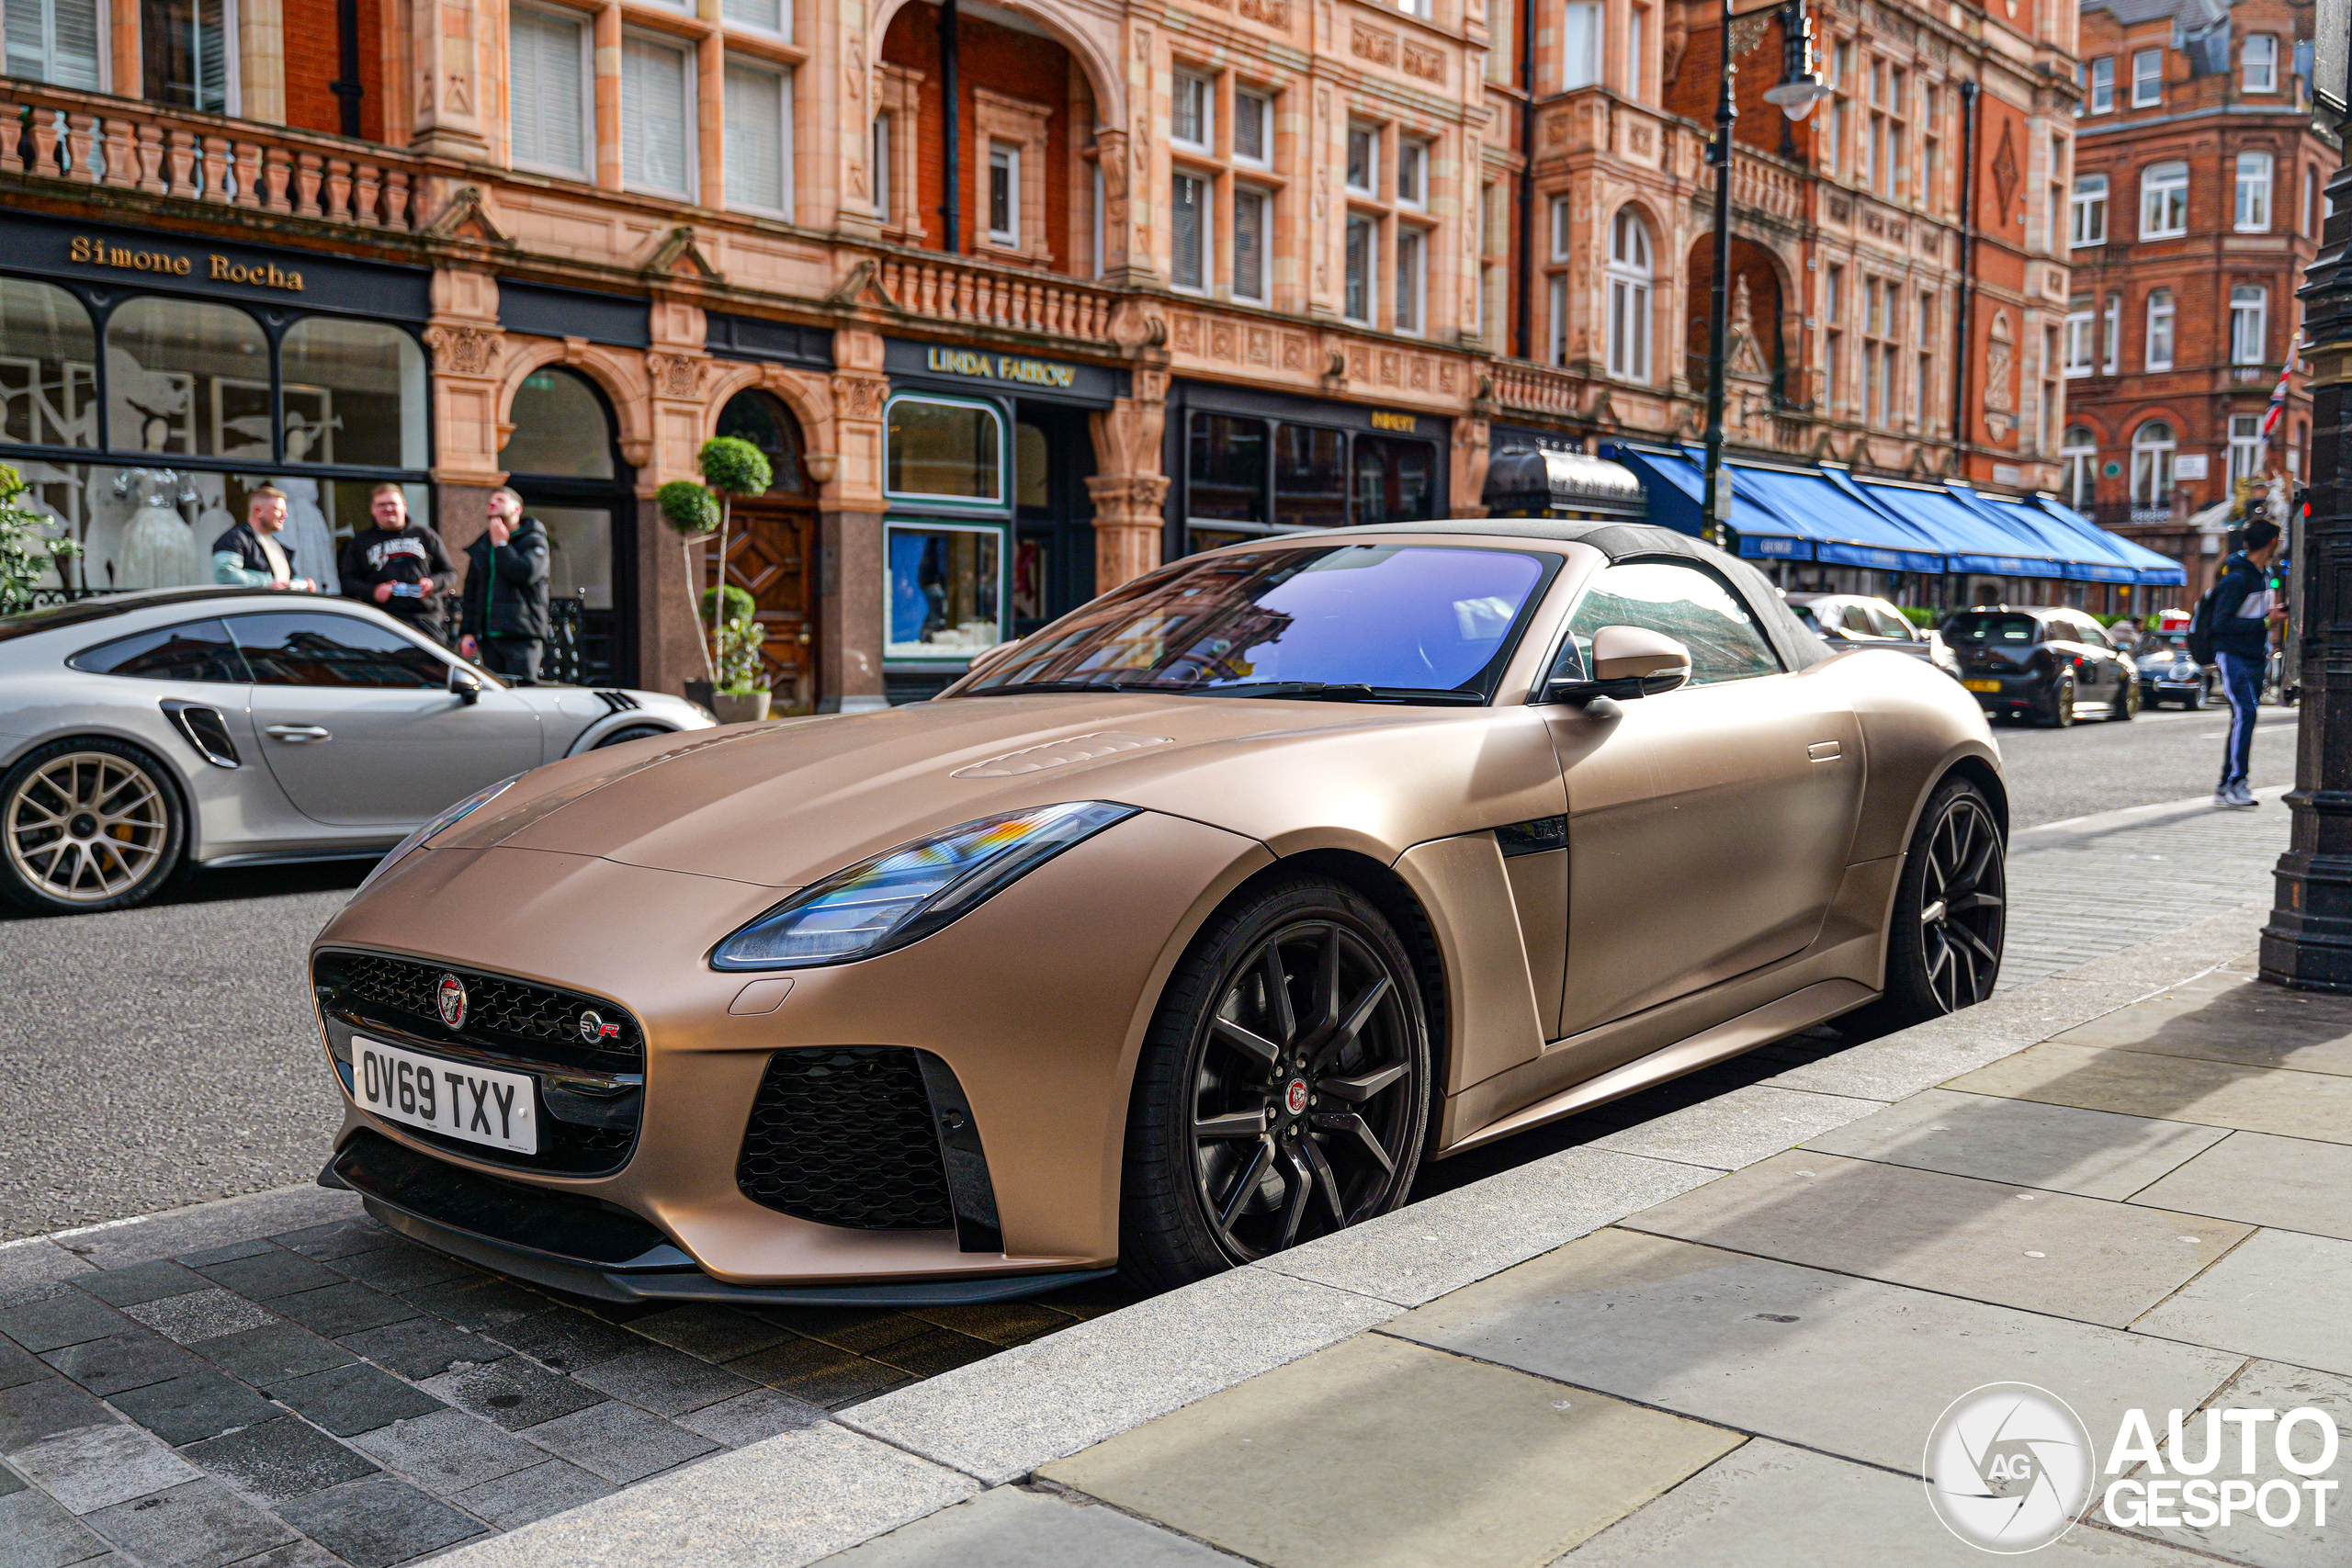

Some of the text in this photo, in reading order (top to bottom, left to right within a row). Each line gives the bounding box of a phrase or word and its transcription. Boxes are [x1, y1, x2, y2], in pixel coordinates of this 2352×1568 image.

[71, 235, 305, 291] Simone Rocha
[928, 347, 993, 378] LINDA
[1500, 825, 1565, 844] JAGUAR
[580, 1019, 620, 1038] SVR
[364, 1050, 514, 1139] OV69 TXY
